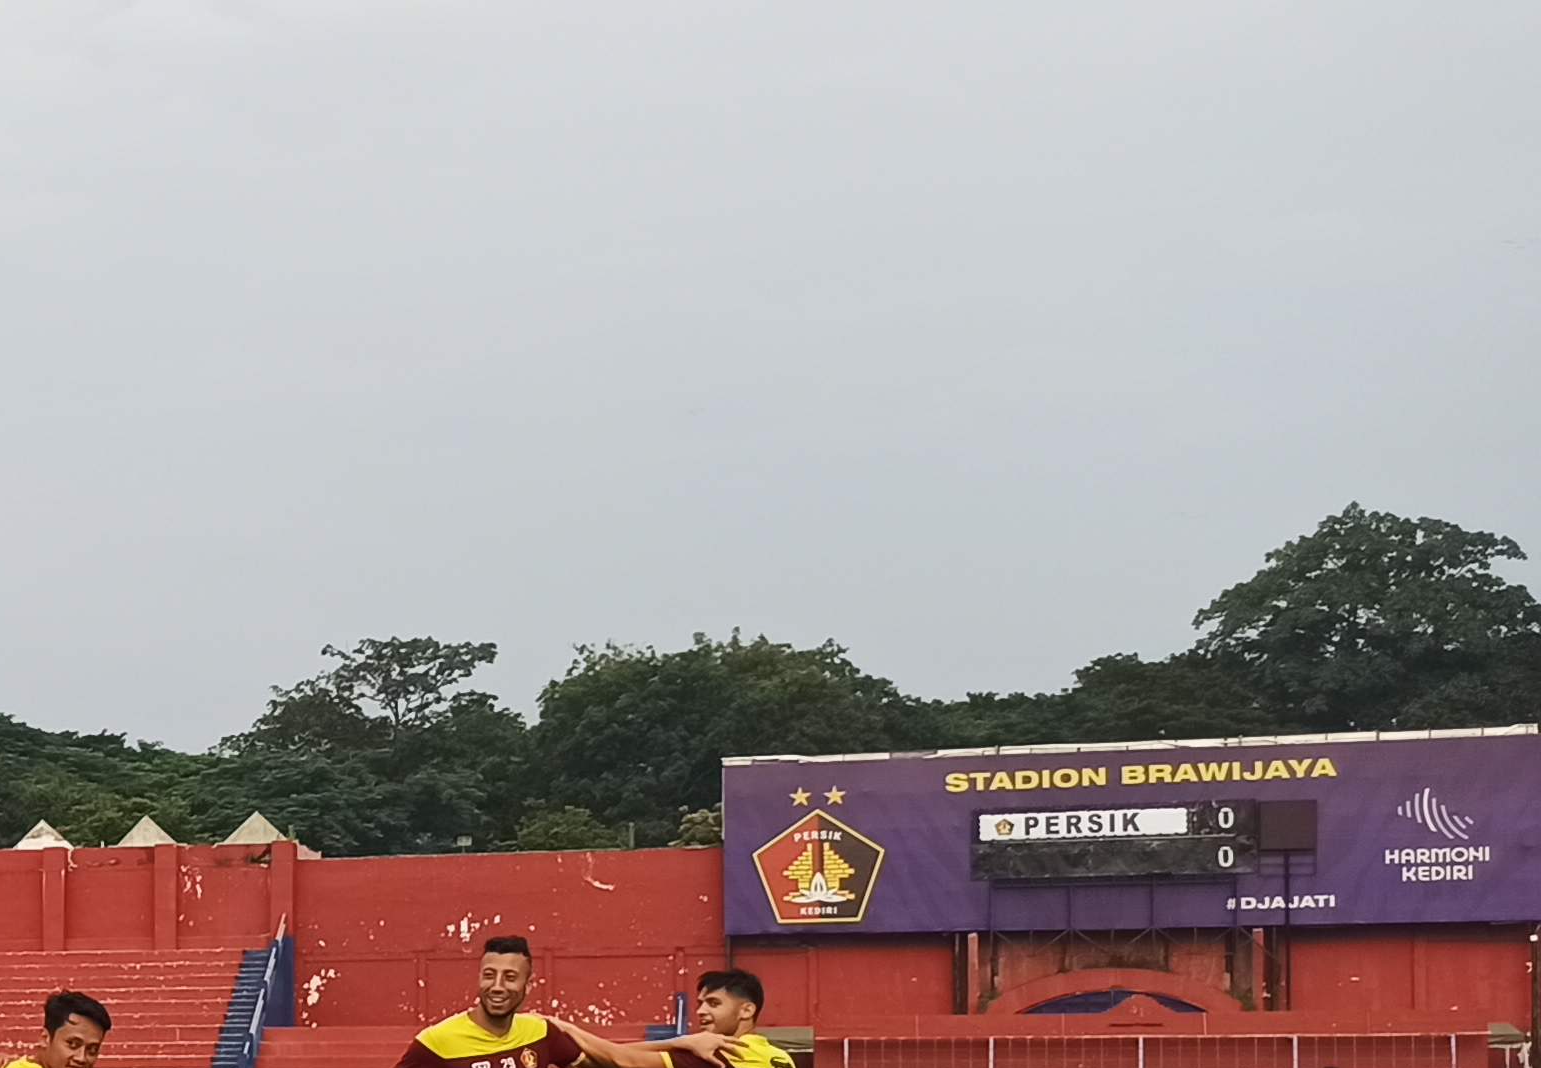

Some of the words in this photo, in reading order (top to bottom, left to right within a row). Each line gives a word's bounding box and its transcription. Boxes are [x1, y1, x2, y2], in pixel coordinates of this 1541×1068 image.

[945, 767, 1107, 793] STADION
[1120, 758, 1337, 785] BRAWIJAYA
[1024, 811, 1141, 836] PERSIK
[1217, 807, 1235, 829] 0
[793, 830, 842, 842] PERSIK
[1217, 846, 1235, 868] 0
[1384, 846, 1490, 865] HARMONI
[1401, 865, 1474, 882] KEDIRI
[799, 906, 838, 916] KEDIRI
